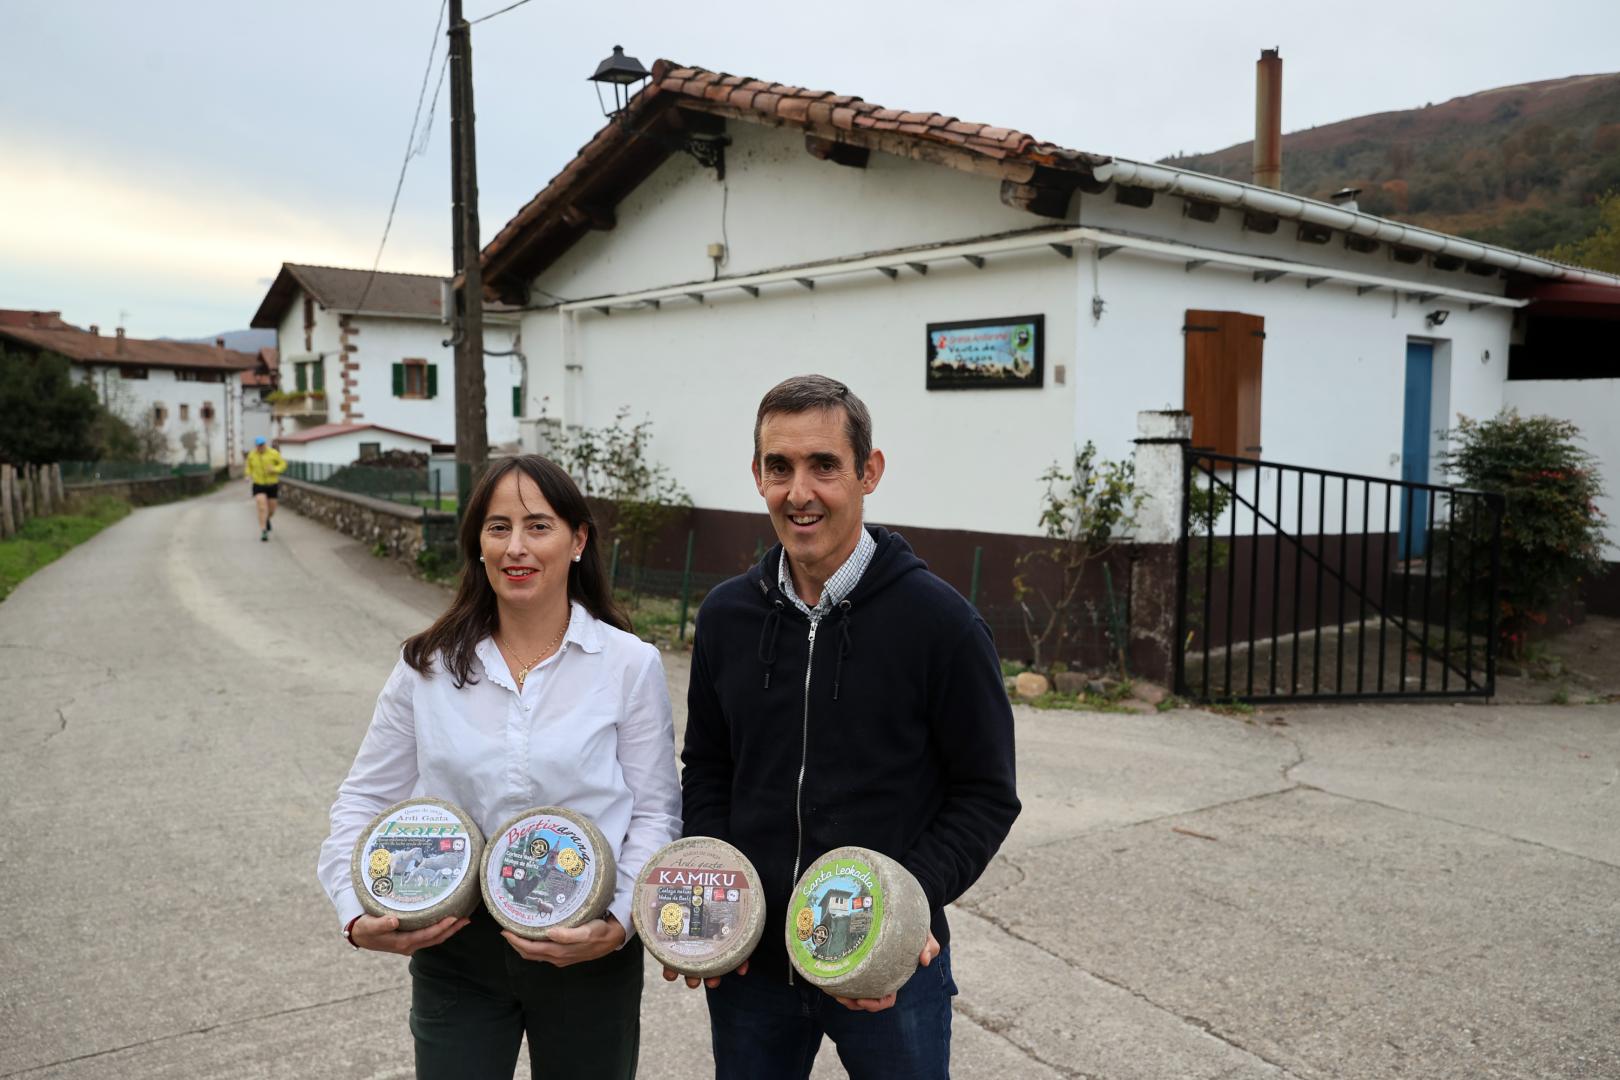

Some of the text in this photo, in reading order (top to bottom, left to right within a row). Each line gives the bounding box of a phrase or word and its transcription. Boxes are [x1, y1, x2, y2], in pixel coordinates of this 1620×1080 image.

[659, 870, 736, 886] KAMIKU
[802, 864, 873, 897] Santa Leokadia
